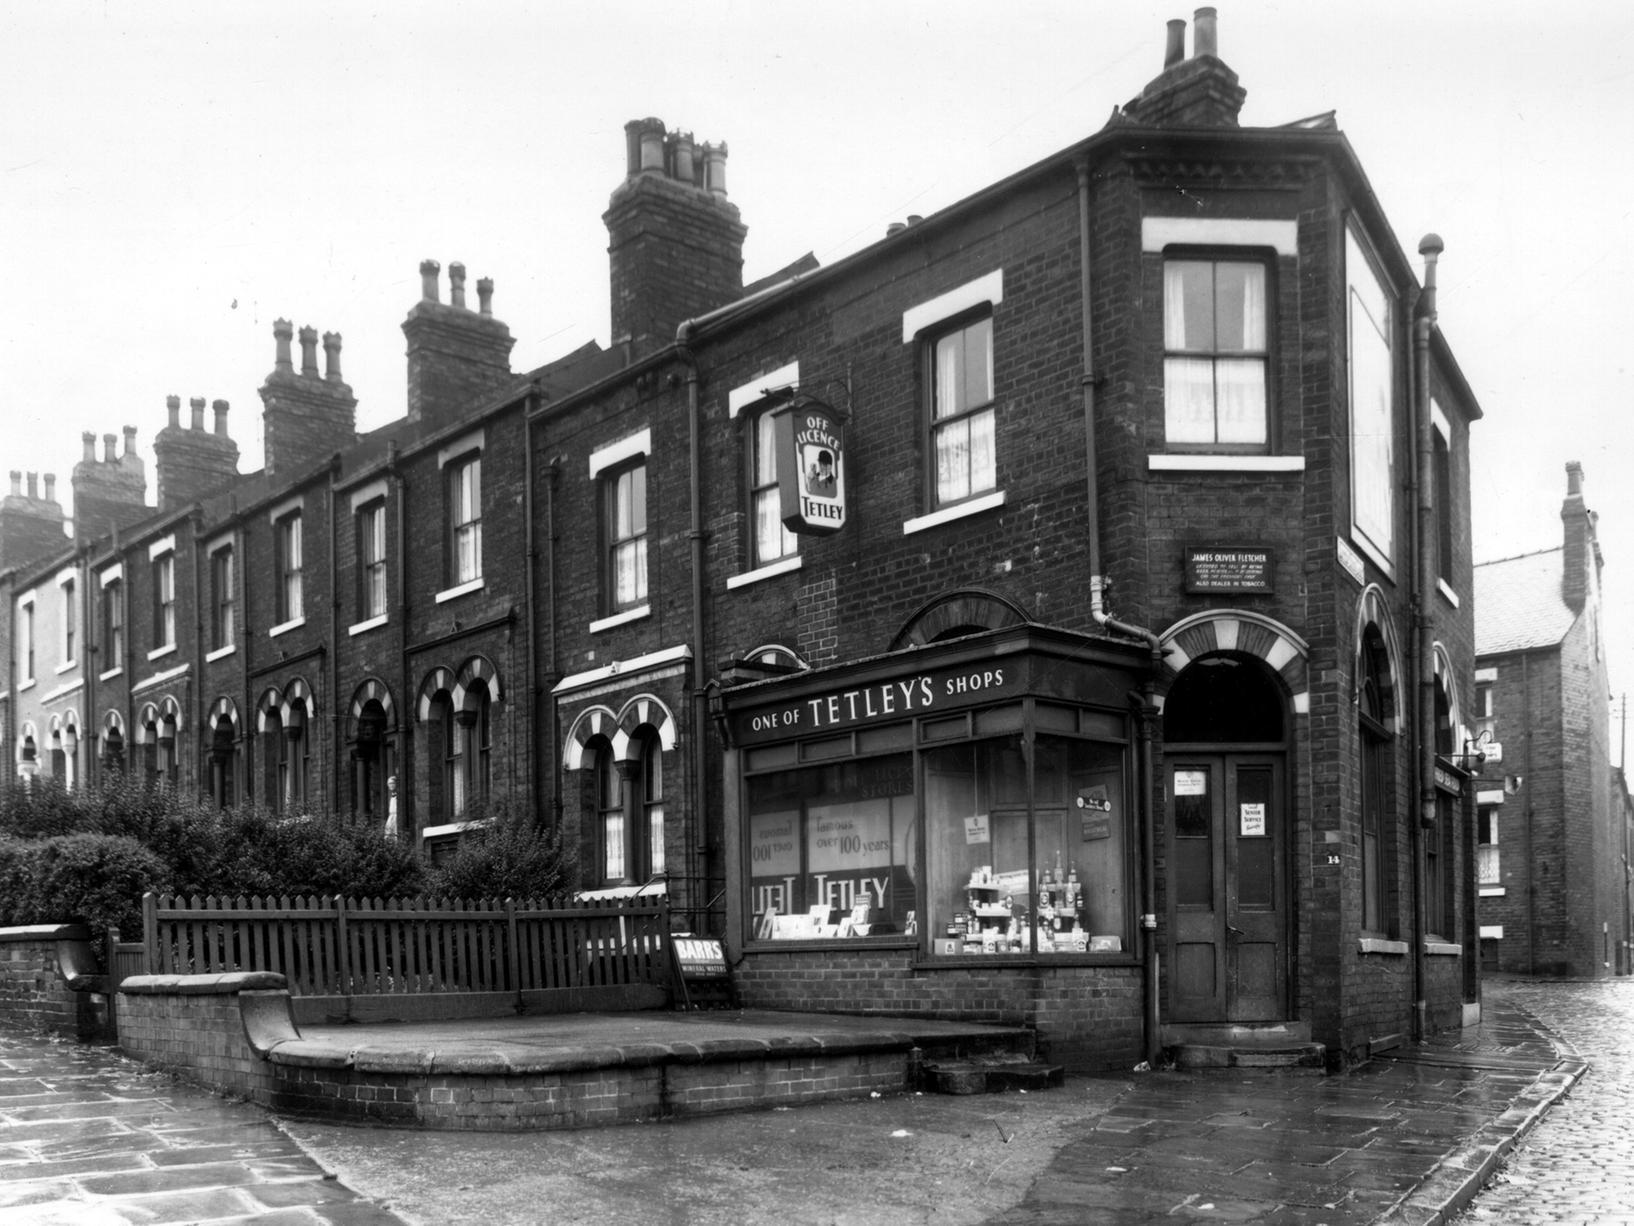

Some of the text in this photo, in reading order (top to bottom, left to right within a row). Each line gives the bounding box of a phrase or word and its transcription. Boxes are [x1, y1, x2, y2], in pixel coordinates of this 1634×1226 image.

[806, 416, 829, 430] OFF
[797, 429, 841, 451] LICENCE
[801, 496, 843, 520] TETLEY
[1191, 553, 1267, 562] JAMES OLIVER FLETCHER
[752, 669, 1003, 731] ONE OF TETLEY'S SHOPS
[816, 835, 890, 857] over 100 years
